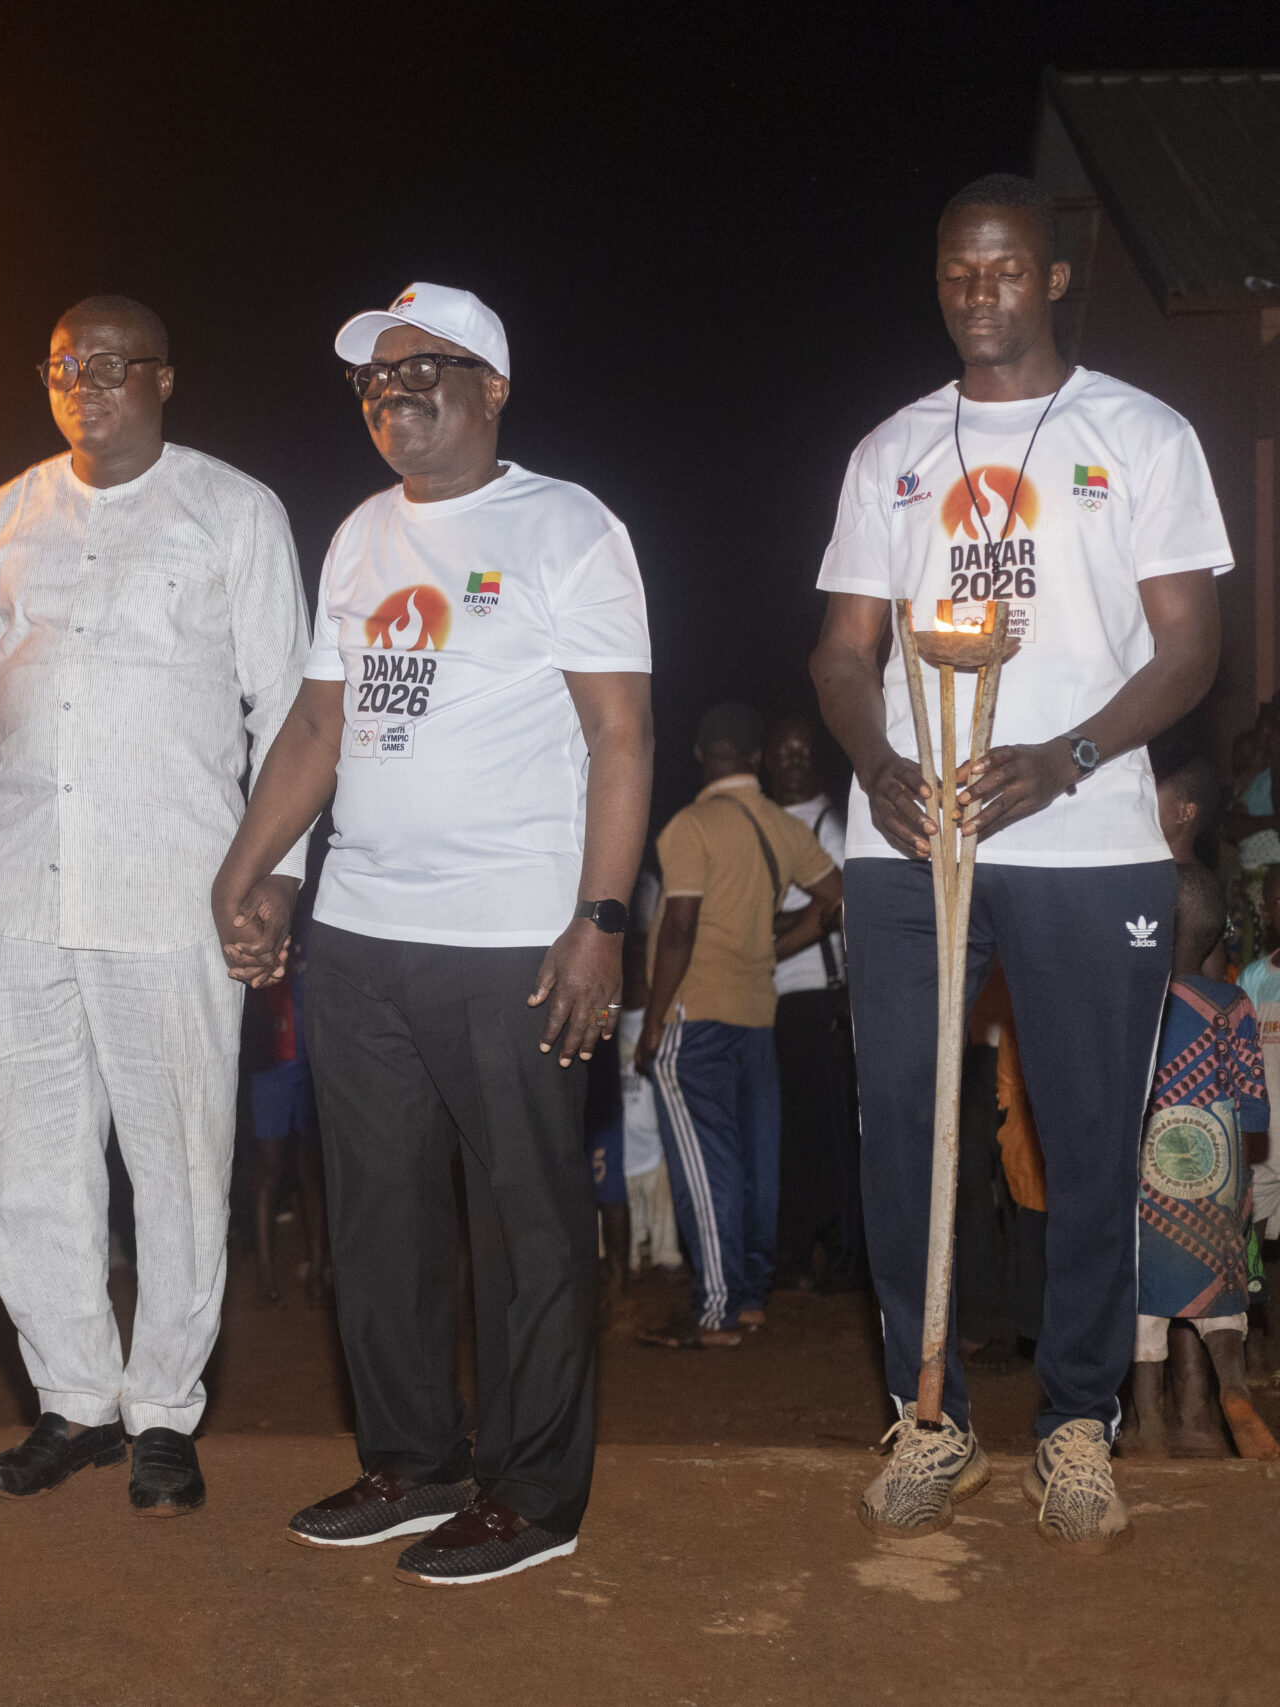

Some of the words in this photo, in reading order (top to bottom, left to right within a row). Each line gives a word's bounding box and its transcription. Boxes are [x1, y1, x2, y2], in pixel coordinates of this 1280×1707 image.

[1072, 487, 1108, 500] BENIN
[950, 538, 1036, 573] DAKAR
[951, 567, 1037, 605] 2026
[463, 594, 499, 605] BENIN
[1008, 618, 1030, 627] MPIC
[362, 654, 437, 685] DAKAR
[357, 682, 429, 717] 2026
[379, 734, 409, 743] OLYMPIC
[381, 743, 405, 751] GAMES
